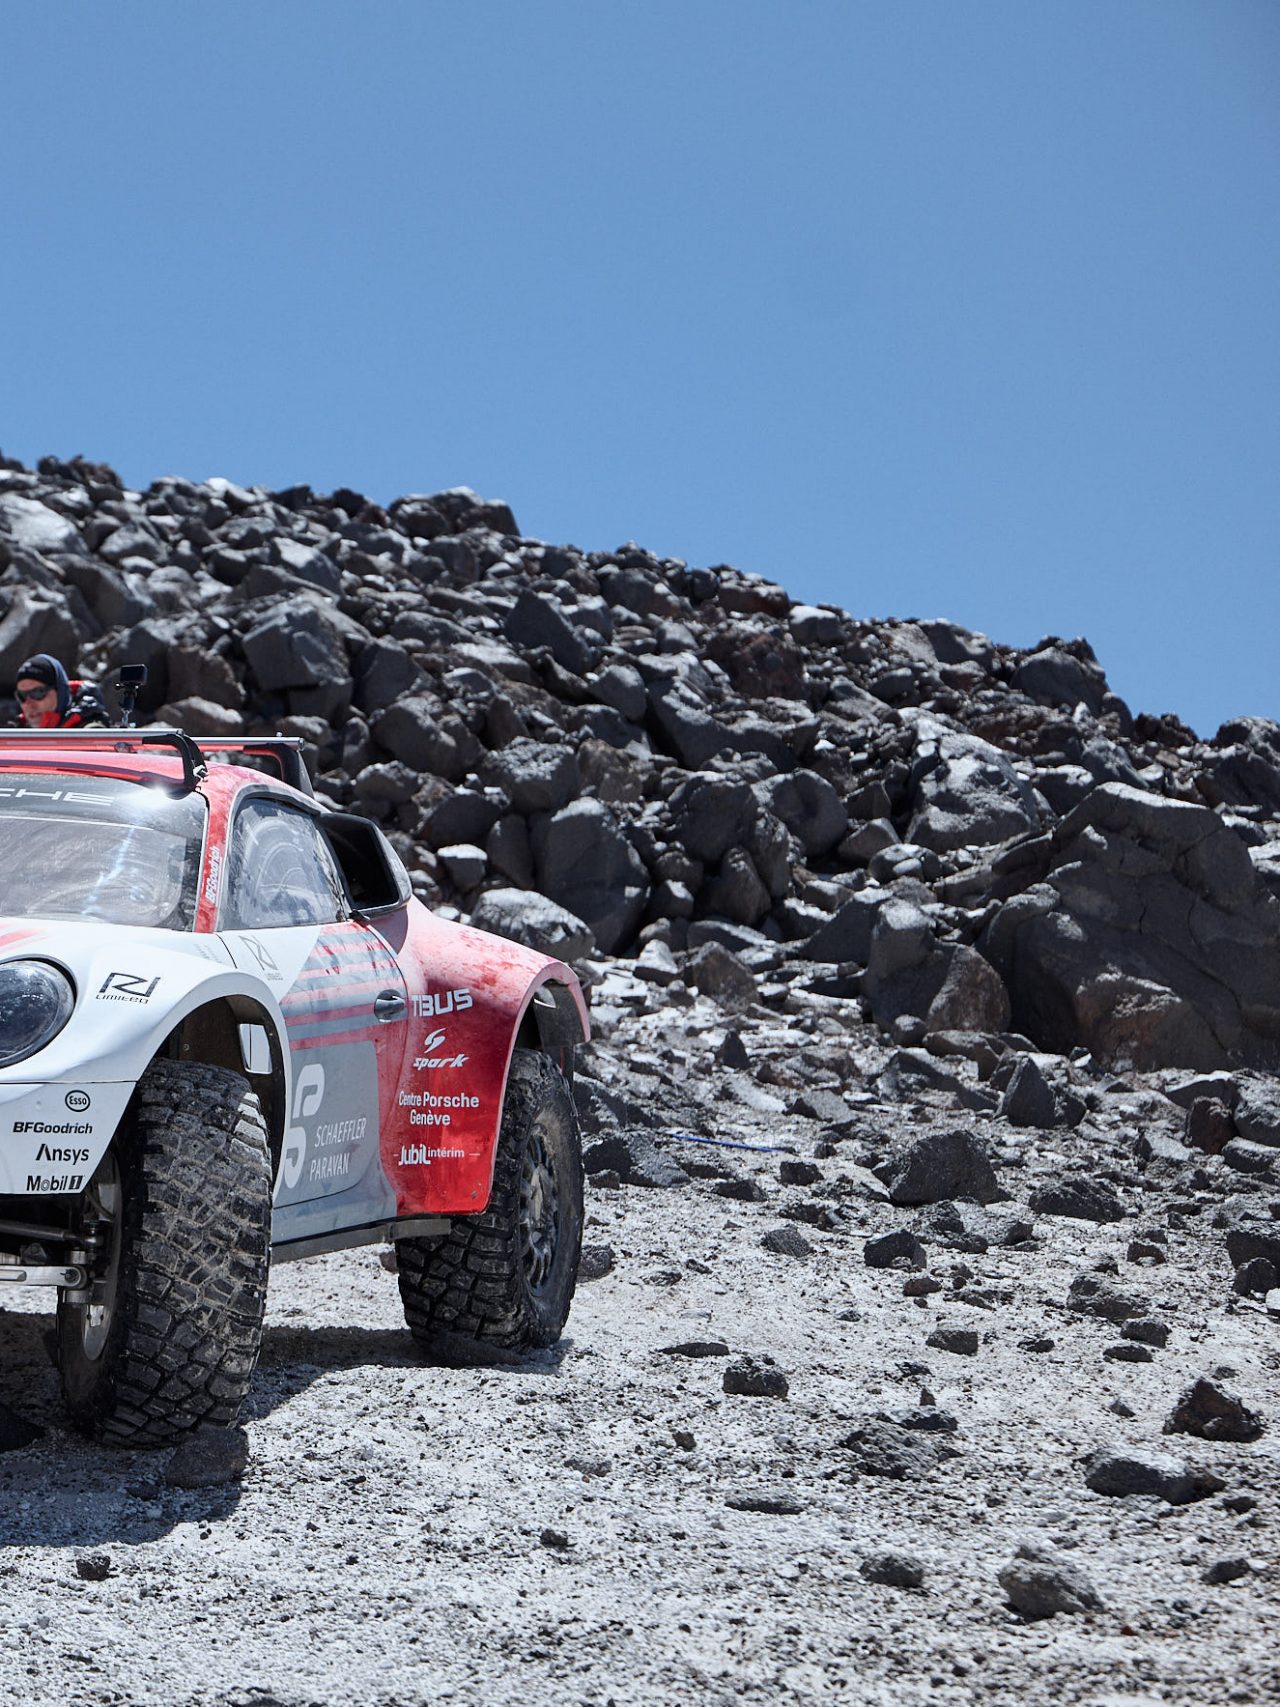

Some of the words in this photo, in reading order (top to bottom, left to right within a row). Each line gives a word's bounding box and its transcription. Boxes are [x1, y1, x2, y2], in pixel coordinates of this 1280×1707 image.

[399, 1091, 422, 1107] Centre
[423, 1091, 480, 1109] Porsche
[410, 1109, 451, 1126] Genève
[13, 1121, 93, 1135] BFGoodrich
[314, 1118, 368, 1149] SCHAEFFLER
[35, 1143, 90, 1166] Ansys
[309, 1152, 350, 1182] PARAVAN
[26, 1175, 68, 1192] Mobil
